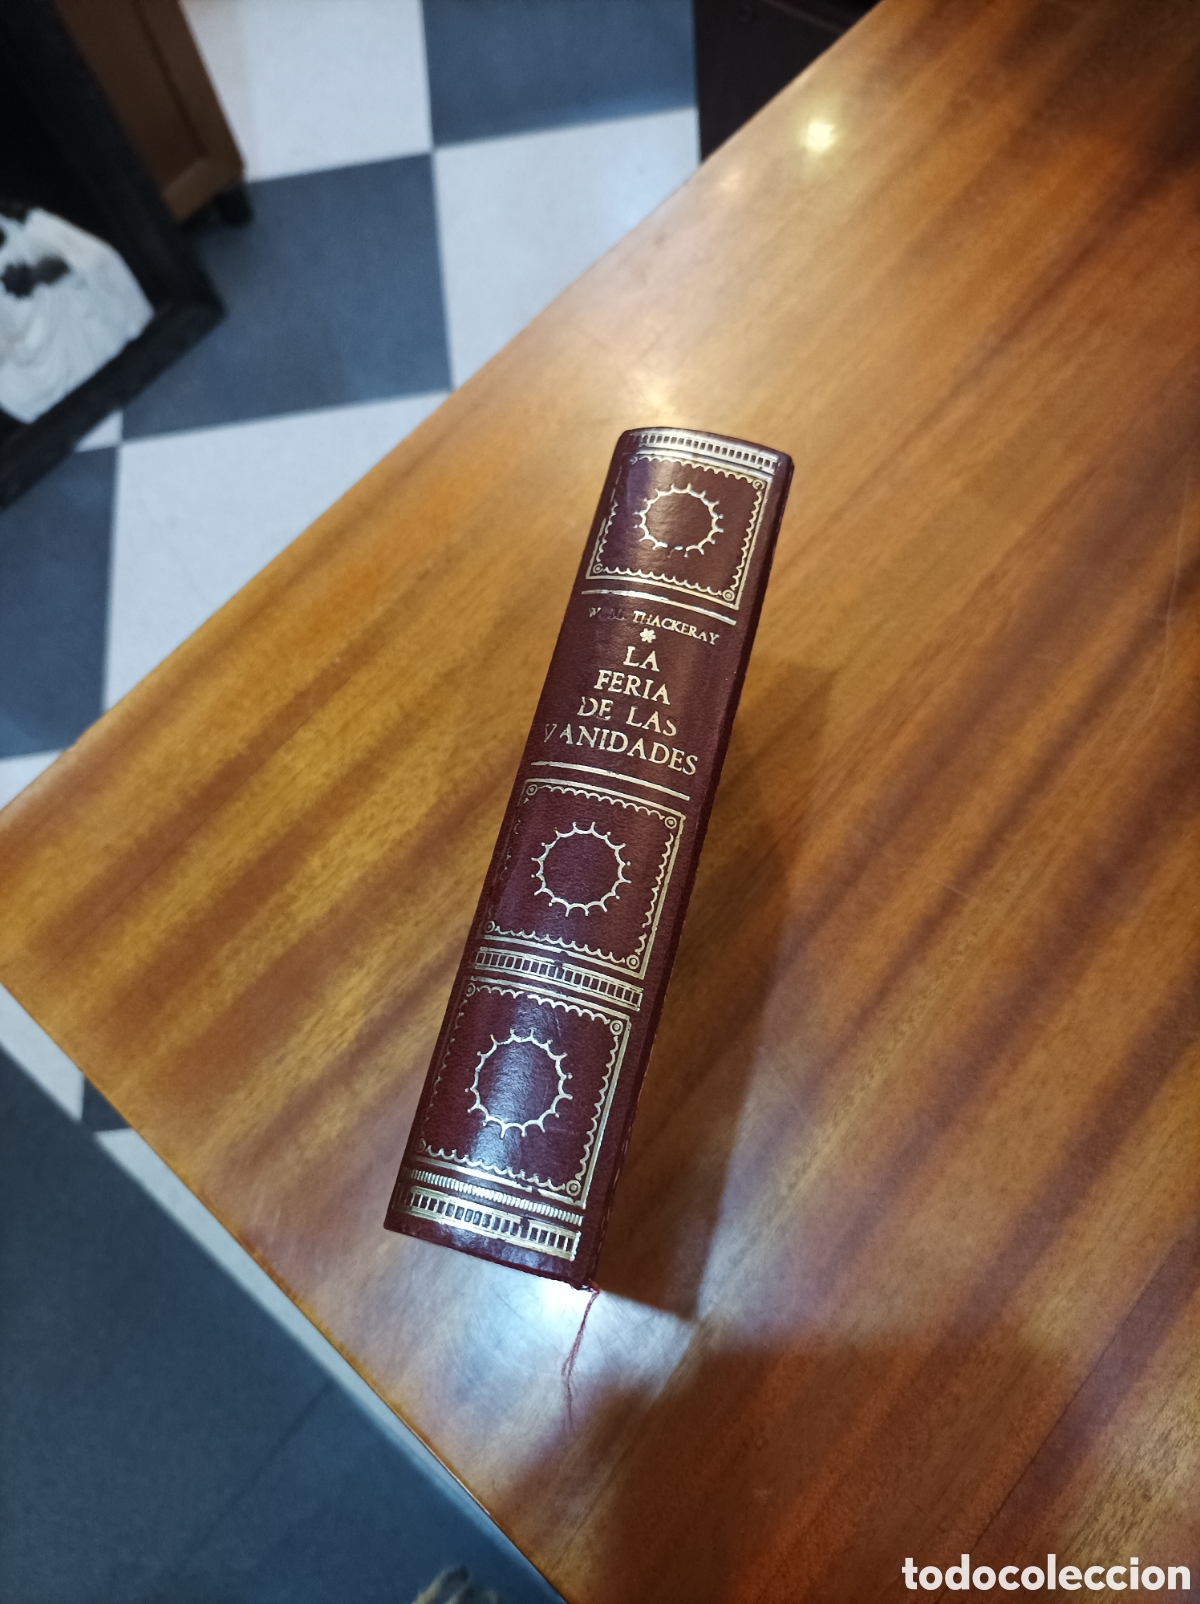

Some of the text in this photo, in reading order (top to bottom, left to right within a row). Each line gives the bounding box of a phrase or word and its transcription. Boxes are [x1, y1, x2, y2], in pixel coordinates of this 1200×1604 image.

[632, 610, 720, 645] THACKERAY
[623, 645, 660, 672] LA
[593, 669, 671, 705] FERIA
[577, 696, 677, 737] DE LAS
[543, 723, 698, 775] VANIDADES
